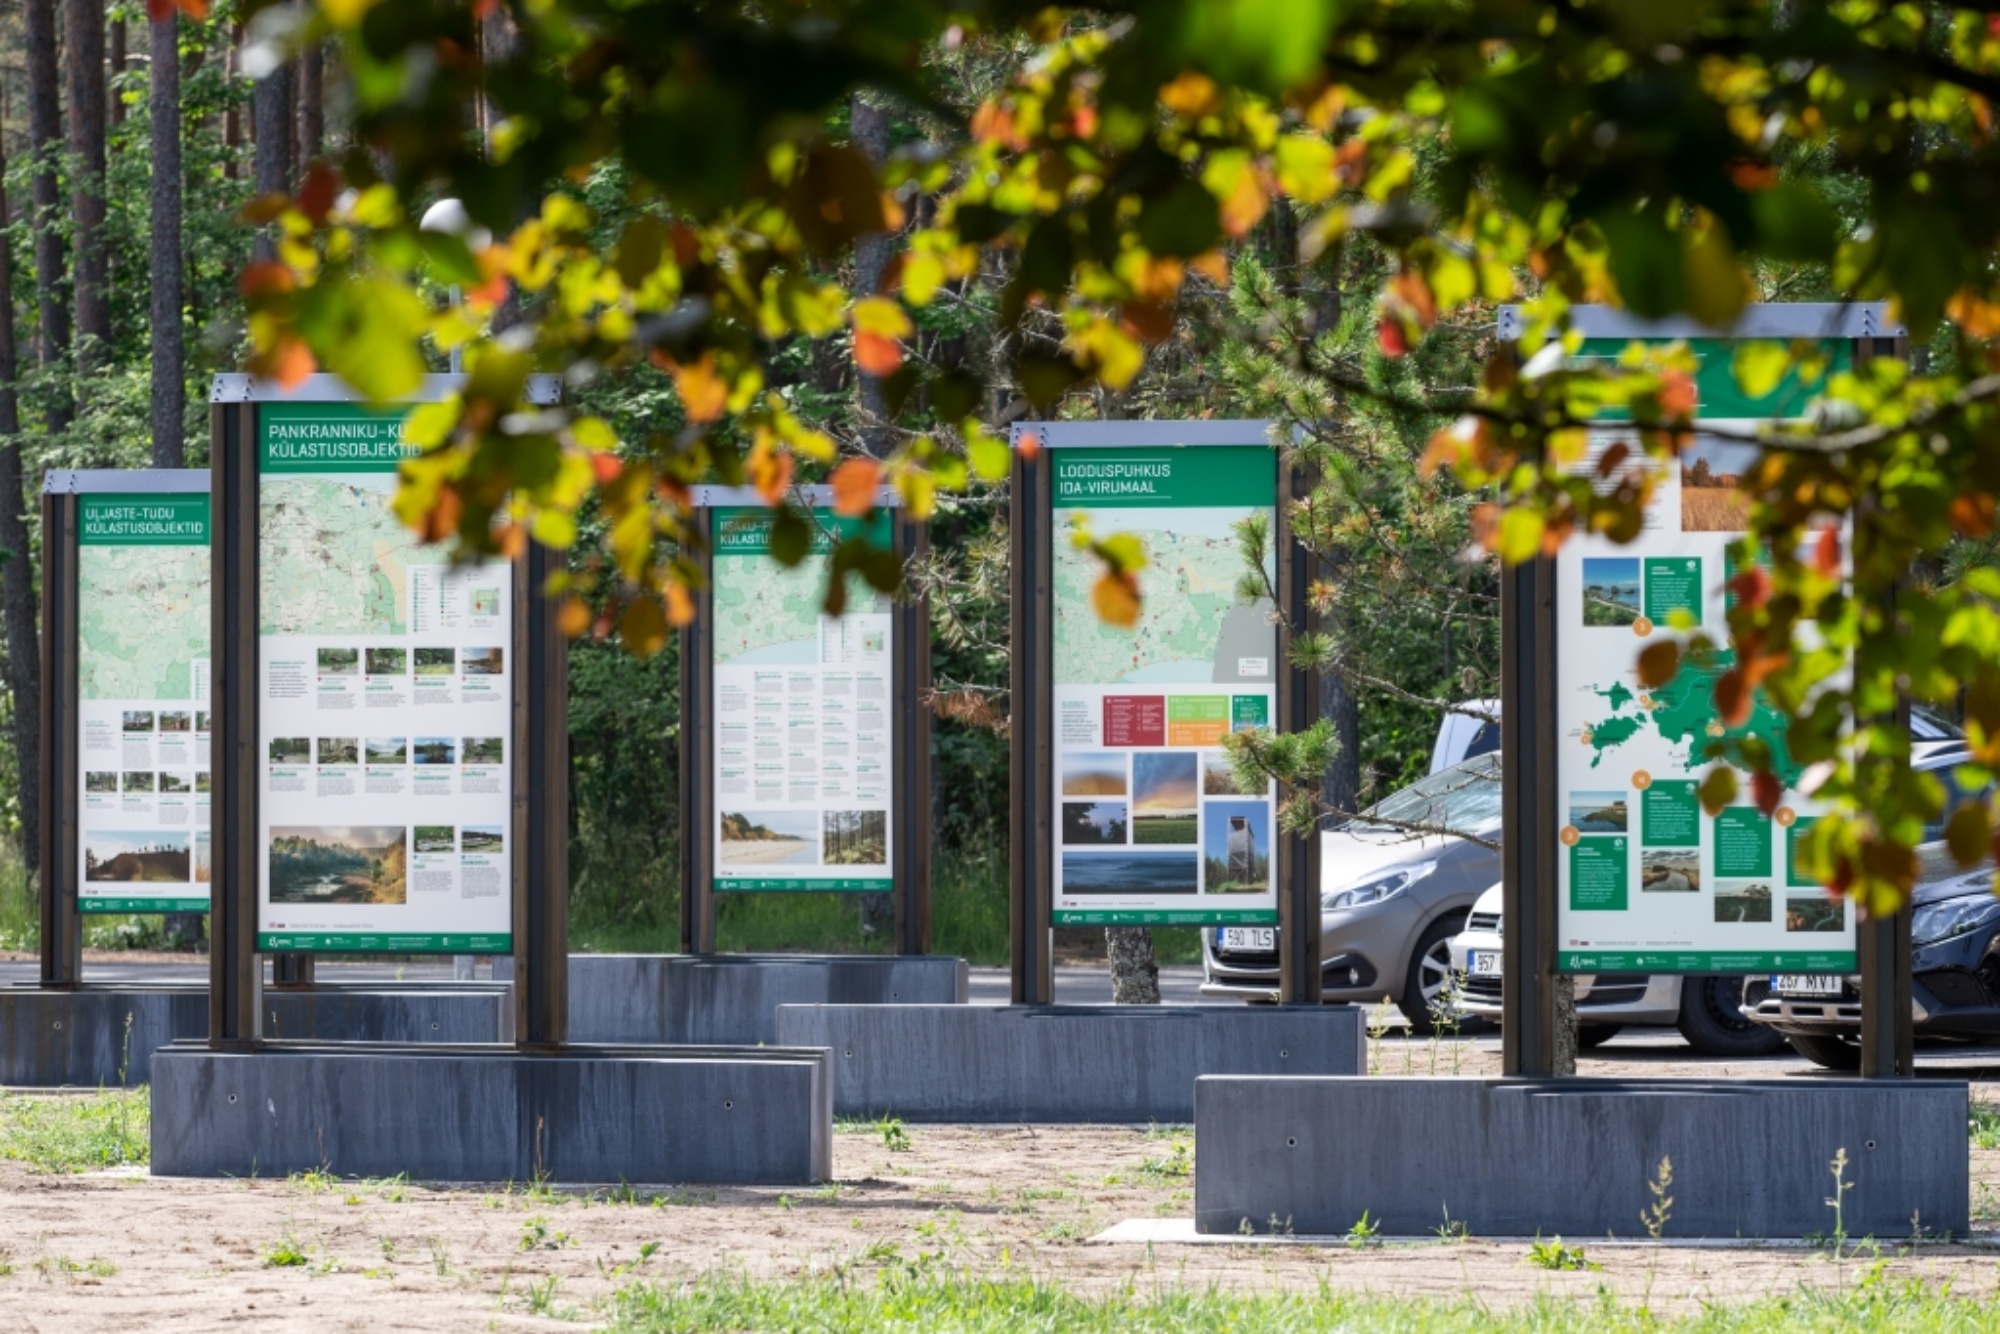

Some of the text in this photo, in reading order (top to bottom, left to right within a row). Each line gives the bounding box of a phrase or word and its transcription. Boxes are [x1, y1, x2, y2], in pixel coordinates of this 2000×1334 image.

[269, 440, 423, 458] KÜLASTUSOBJEKTID
[1060, 464, 1171, 478] LOODUSPUHKUS
[1060, 481, 1157, 495] IDA-VIRUMAAL
[85, 507, 175, 521] ULJASTE-TUDU
[85, 520, 203, 534] KÜLASTUSOBJEKTID
